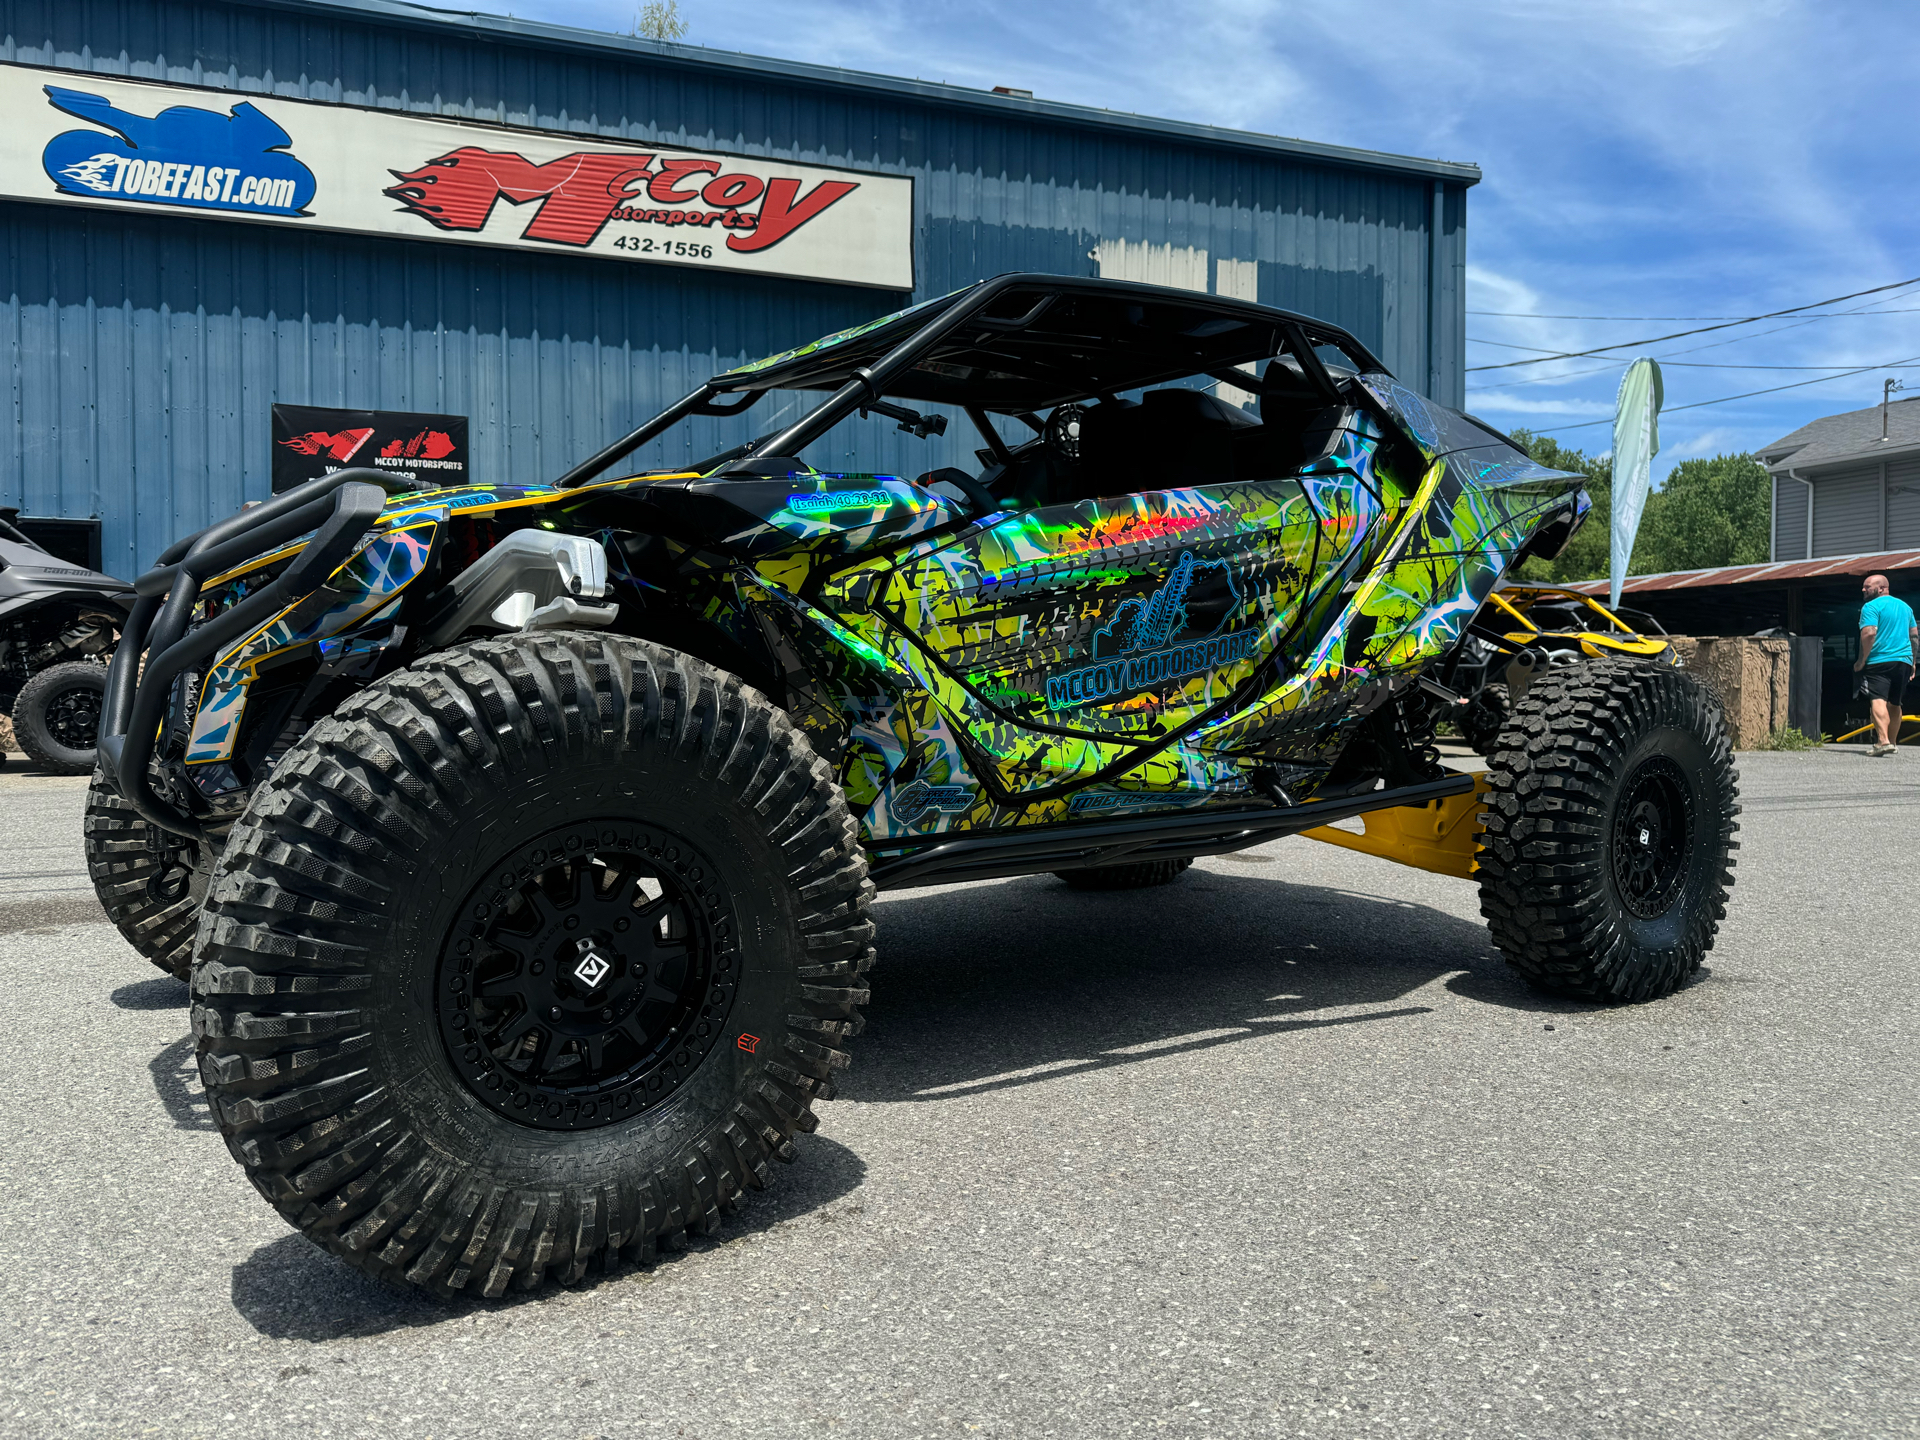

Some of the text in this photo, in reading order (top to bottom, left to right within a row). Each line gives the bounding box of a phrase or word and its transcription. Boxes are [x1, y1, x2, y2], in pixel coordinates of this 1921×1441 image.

[111, 157, 296, 208] TOBEFAST.com
[613, 235, 713, 259] 432-1556
[375, 457, 463, 471] MCCOY MOTORSPORTS
[795, 492, 889, 510] Isaiah 40:28-31
[1049, 630, 1260, 707] MCCOY MOTORSPORTS
